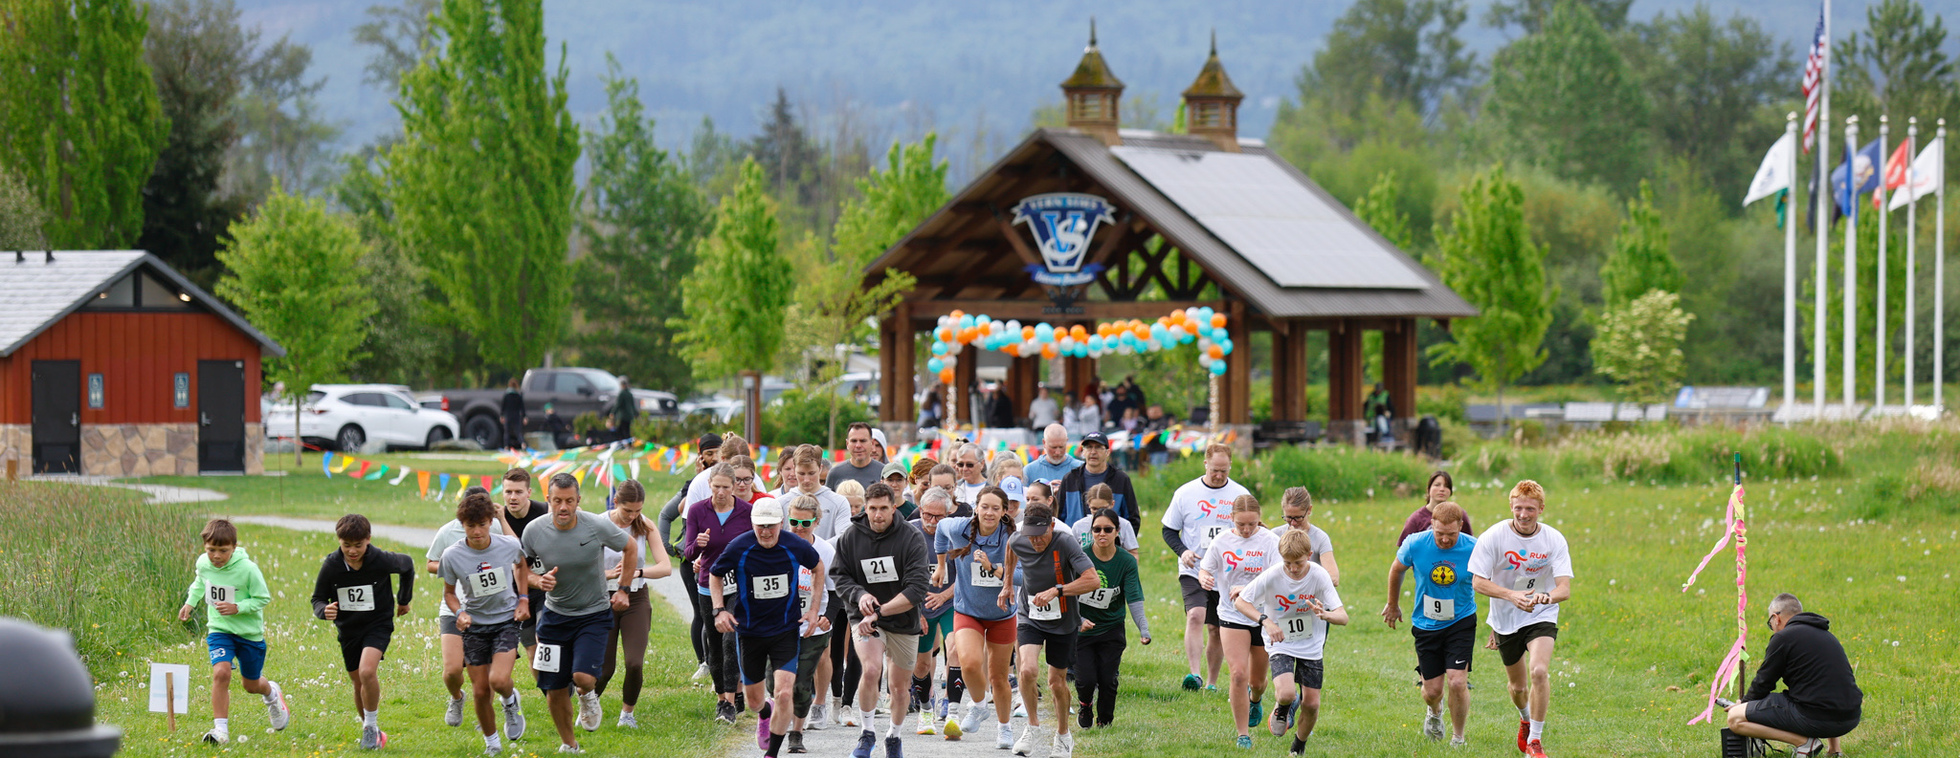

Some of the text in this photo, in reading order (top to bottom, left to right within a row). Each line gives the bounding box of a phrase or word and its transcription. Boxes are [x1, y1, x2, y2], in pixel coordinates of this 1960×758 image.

[870, 560, 887, 574] 21
[478, 572, 496, 588] 59
[763, 577, 779, 591] 35
[1527, 579, 1535, 589] 8
[211, 586, 225, 601] 60
[347, 588, 363, 602] 62
[1089, 589, 1106, 601] 15
[1434, 600, 1441, 613] 9
[1288, 618, 1304, 633] 10
[538, 647, 551, 662] 58
